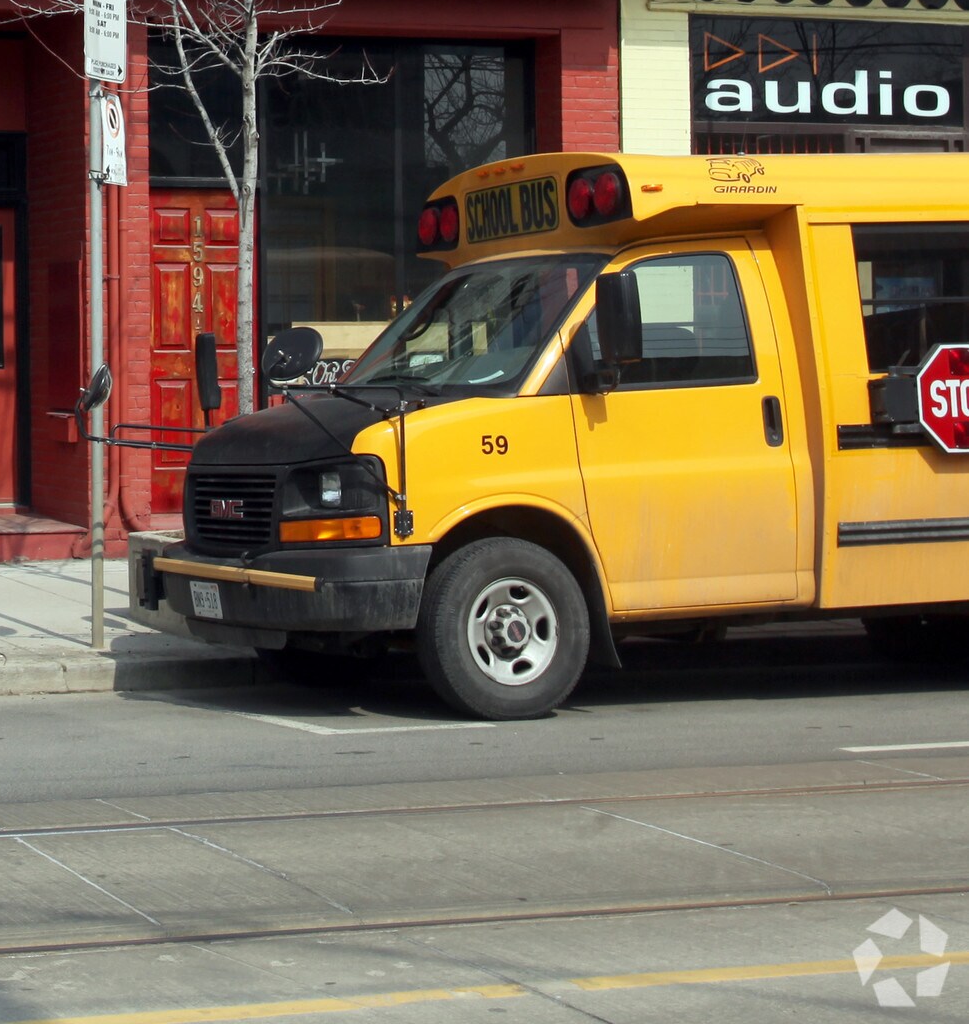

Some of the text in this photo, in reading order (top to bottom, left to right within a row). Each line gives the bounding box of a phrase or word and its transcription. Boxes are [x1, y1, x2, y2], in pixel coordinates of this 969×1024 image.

[704, 70, 951, 117] audio
[713, 185, 778, 194] GIRARDIN
[467, 180, 556, 241] SCHOOL BUS
[481, 435, 509, 455] 59
[210, 499, 244, 519] GMC
